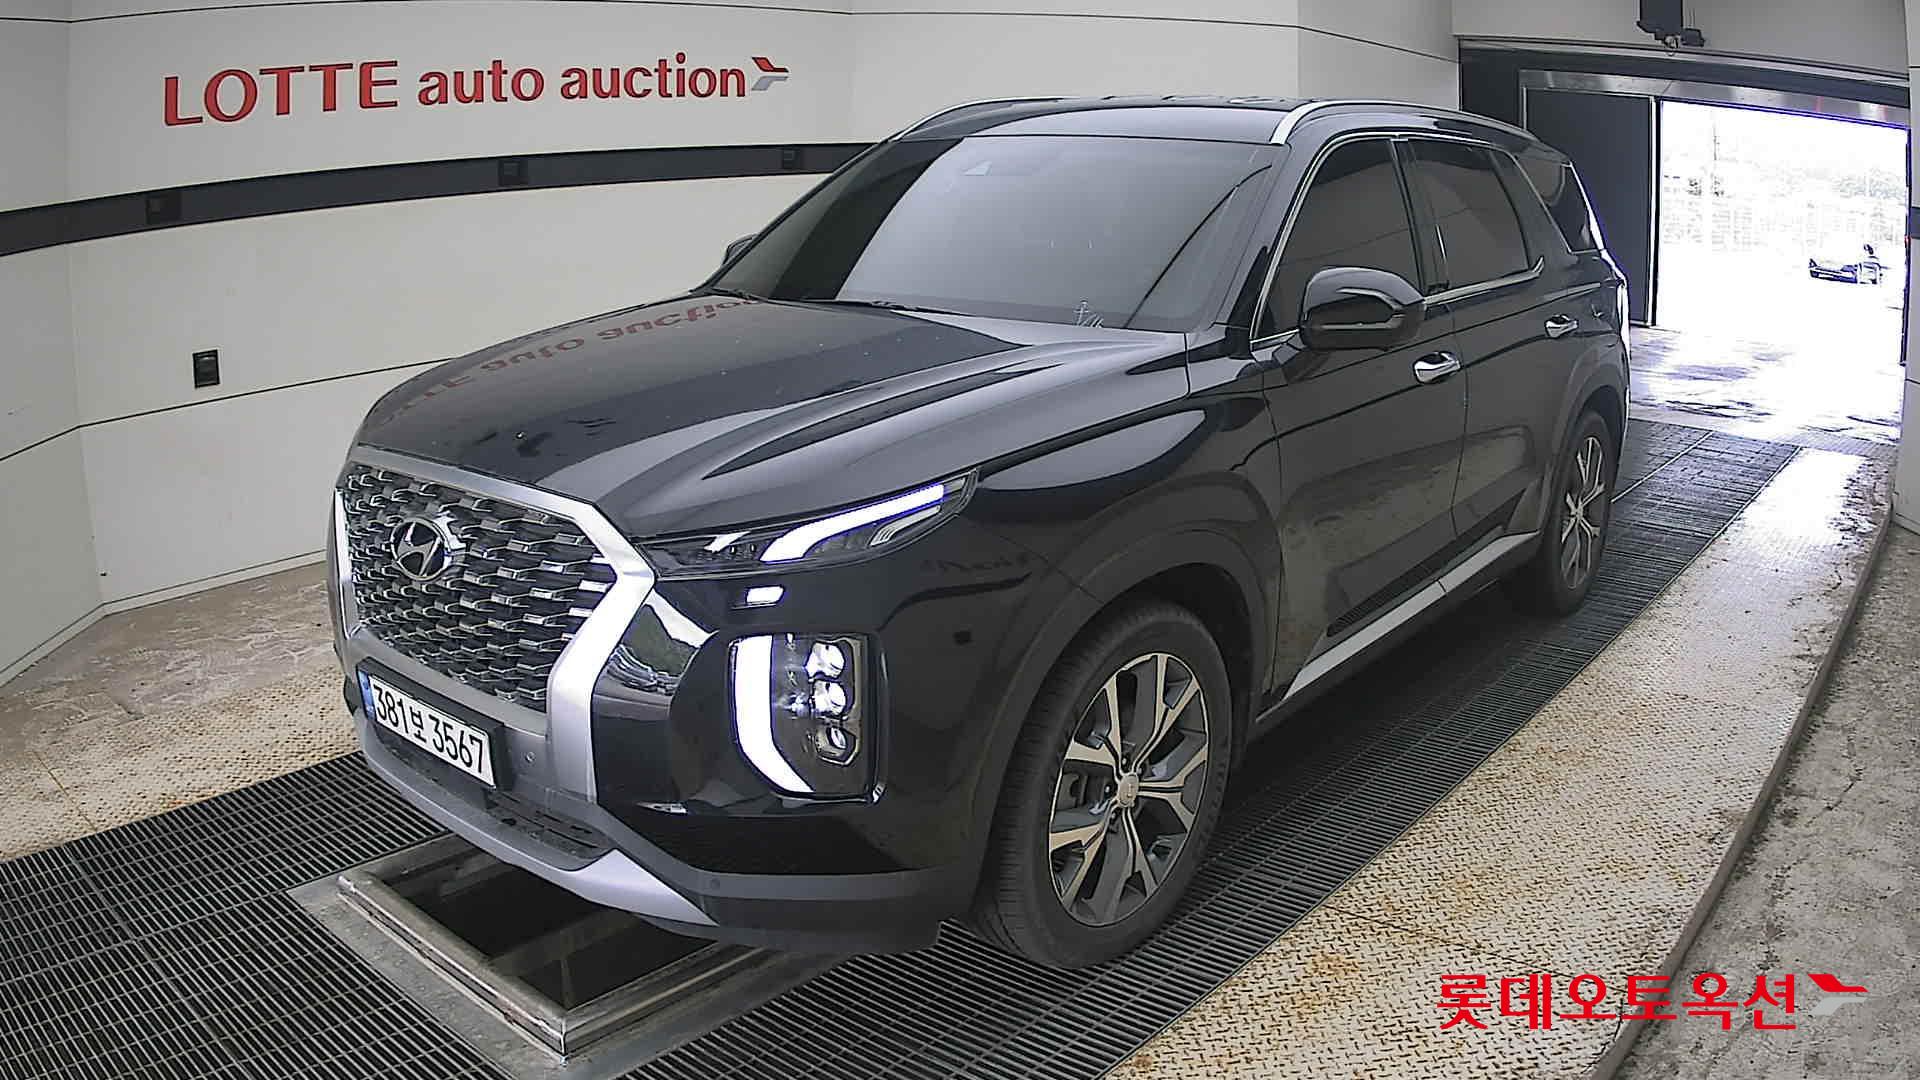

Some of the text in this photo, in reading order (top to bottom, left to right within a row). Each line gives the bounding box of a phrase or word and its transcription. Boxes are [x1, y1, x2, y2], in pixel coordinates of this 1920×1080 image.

[163, 51, 747, 126] LOTTE auto auction
